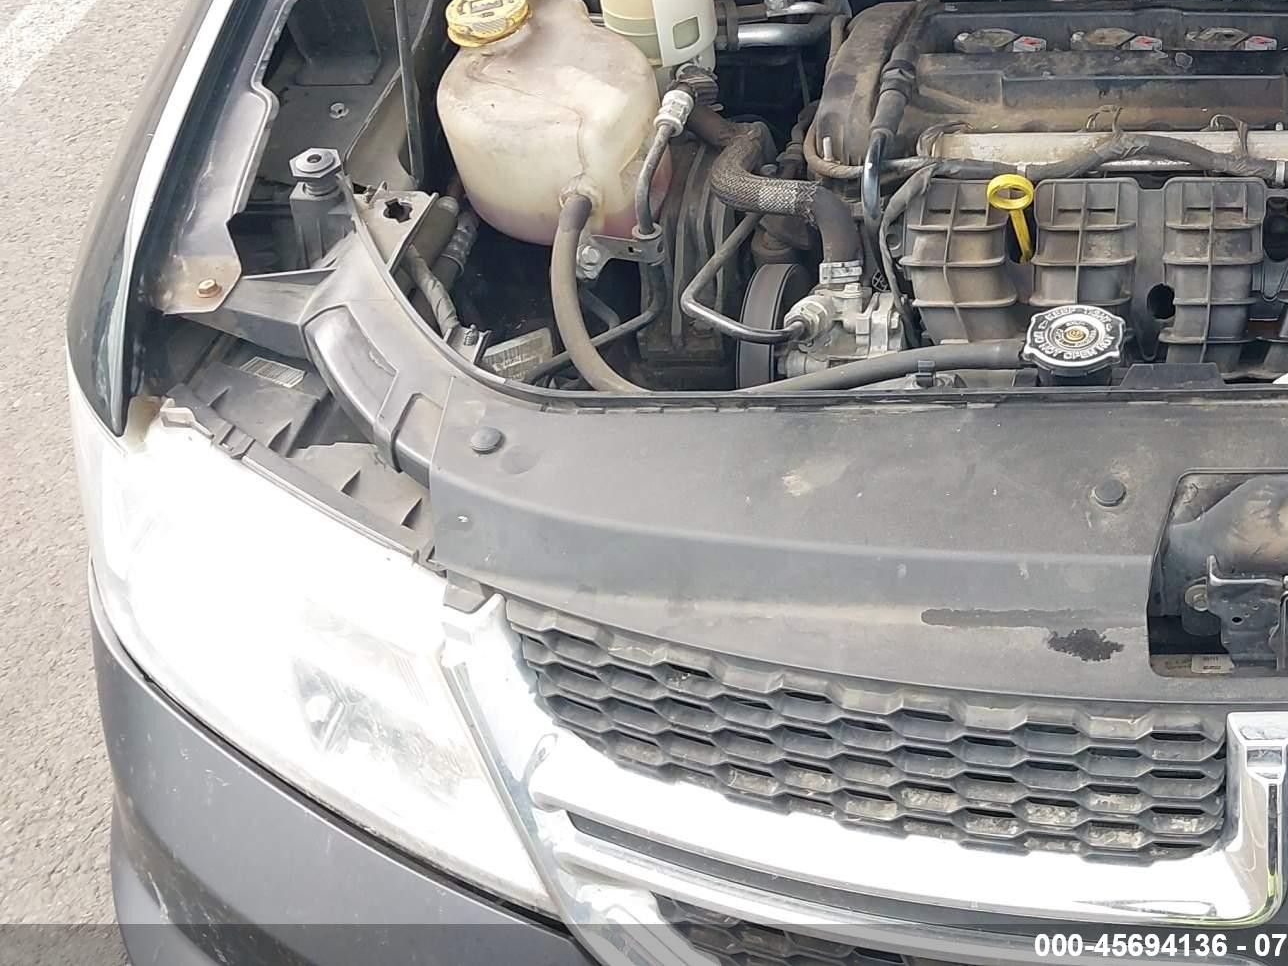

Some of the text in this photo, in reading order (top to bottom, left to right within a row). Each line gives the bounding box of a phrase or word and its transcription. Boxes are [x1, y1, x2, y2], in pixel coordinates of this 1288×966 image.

[1033, 330, 1045, 344] DO
[1096, 335, 1116, 352] HOT
[1038, 342, 1062, 357] NOT
[1063, 347, 1098, 360] OPEN
